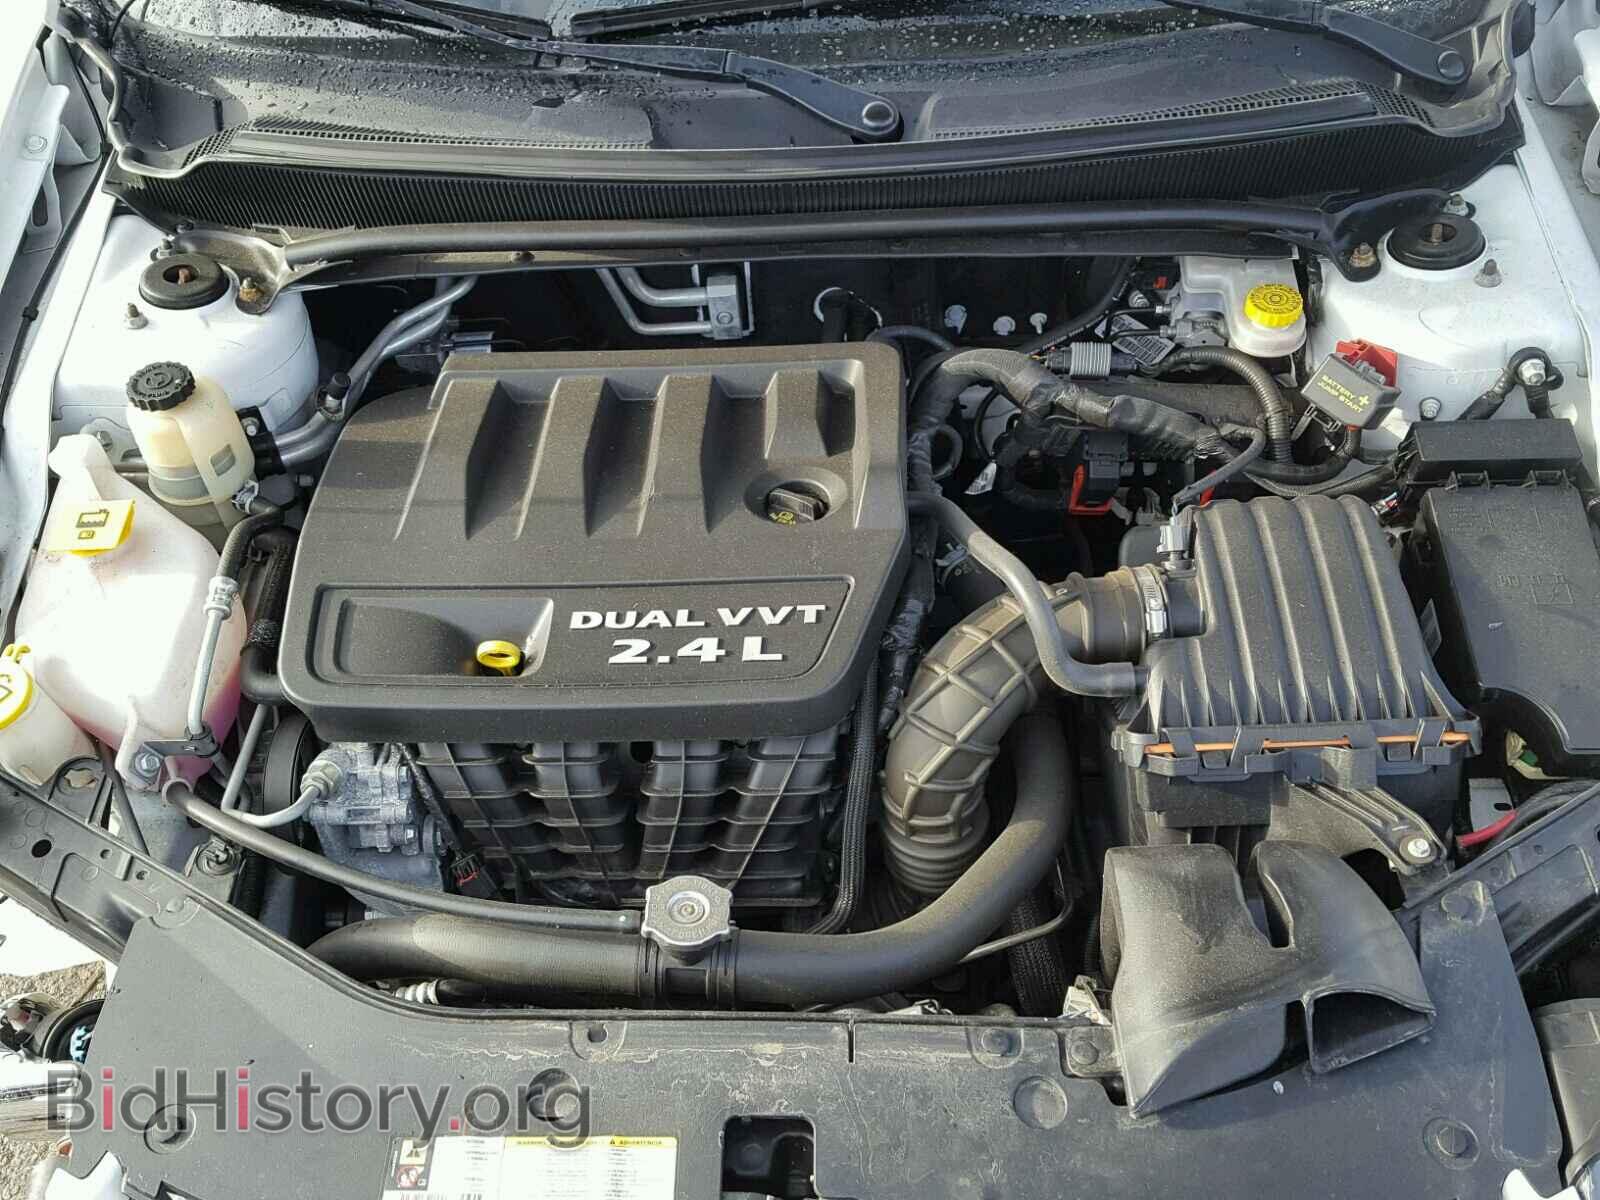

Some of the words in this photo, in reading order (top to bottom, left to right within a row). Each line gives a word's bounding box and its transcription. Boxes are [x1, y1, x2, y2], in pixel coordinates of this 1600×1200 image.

[1321, 375, 1356, 400] BATTERY
[1338, 395, 1362, 414] START
[569, 609, 707, 630] DUAL
[716, 604, 827, 628] VVT
